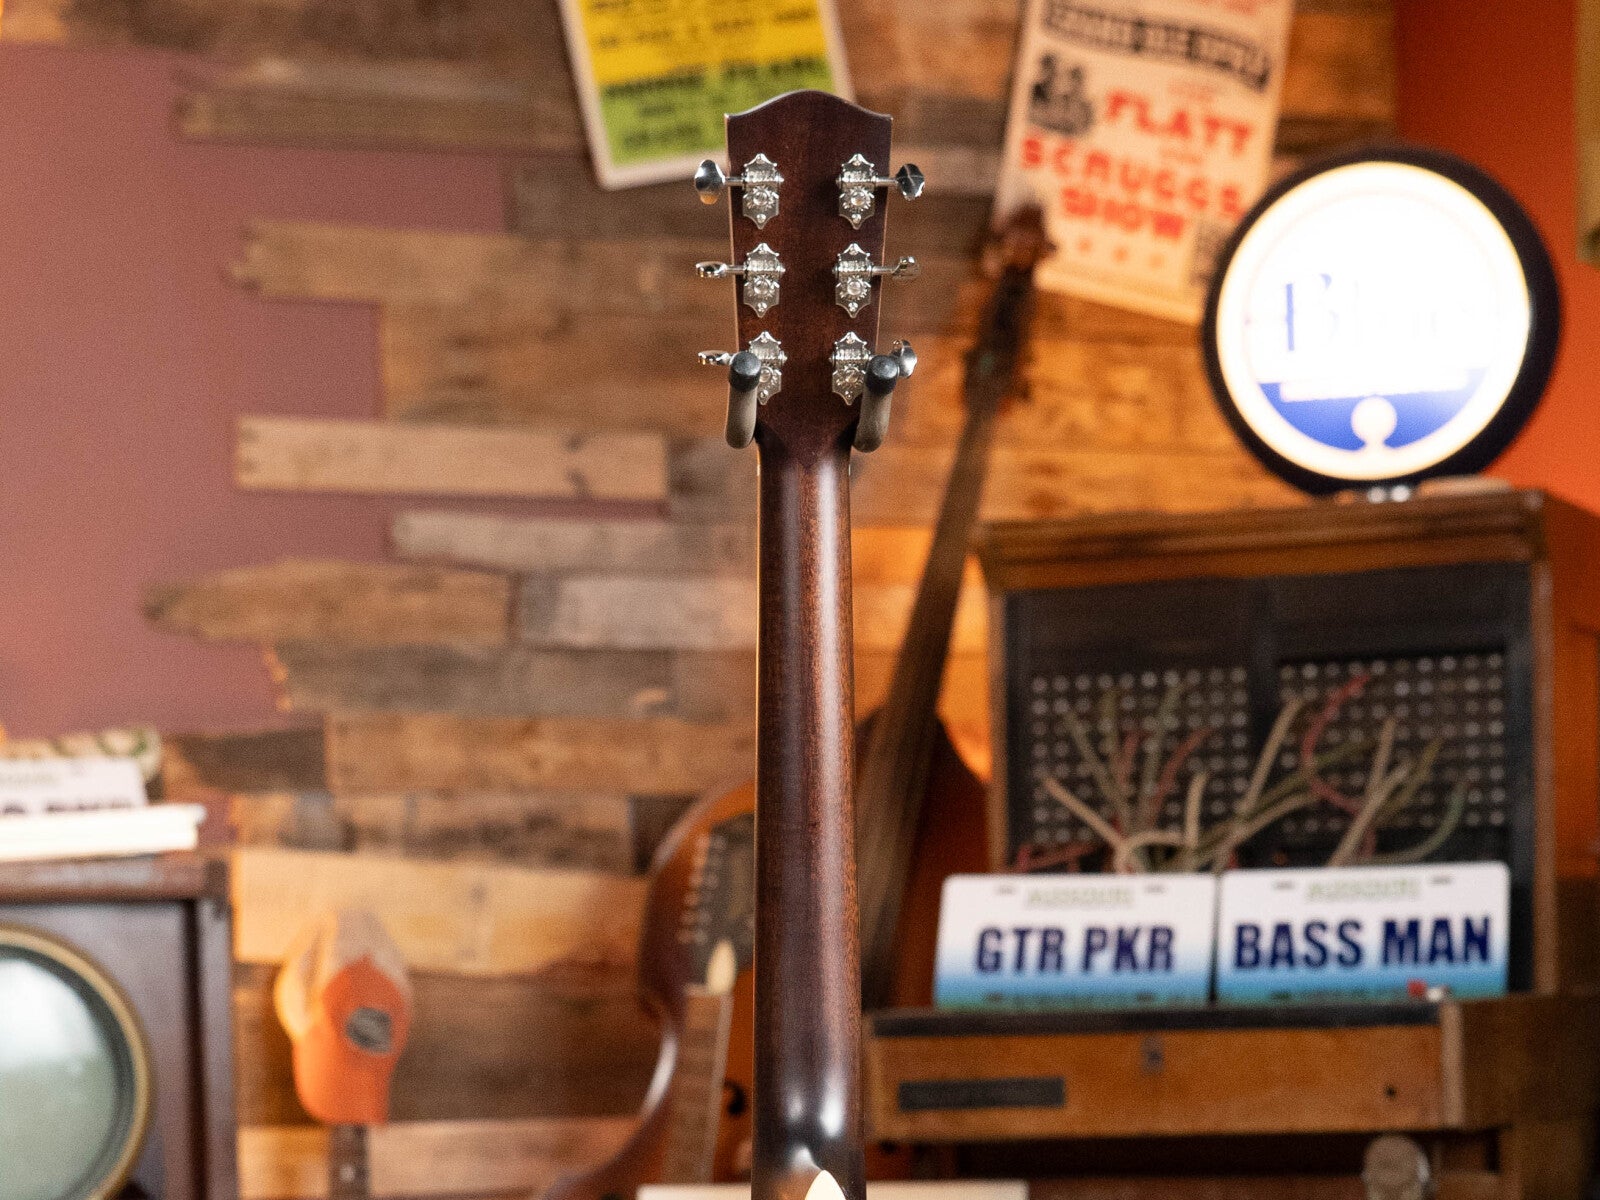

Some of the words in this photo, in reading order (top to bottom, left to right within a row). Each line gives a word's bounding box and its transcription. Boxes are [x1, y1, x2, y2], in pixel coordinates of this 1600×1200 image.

[1105, 90, 1253, 156] FLATT
[1021, 135, 1249, 223] SCRUGGS
[977, 925, 1065, 974] GTR
[1082, 924, 1176, 973] PKR
[1234, 918, 1365, 971] BASS
[1381, 914, 1491, 968] MAN
